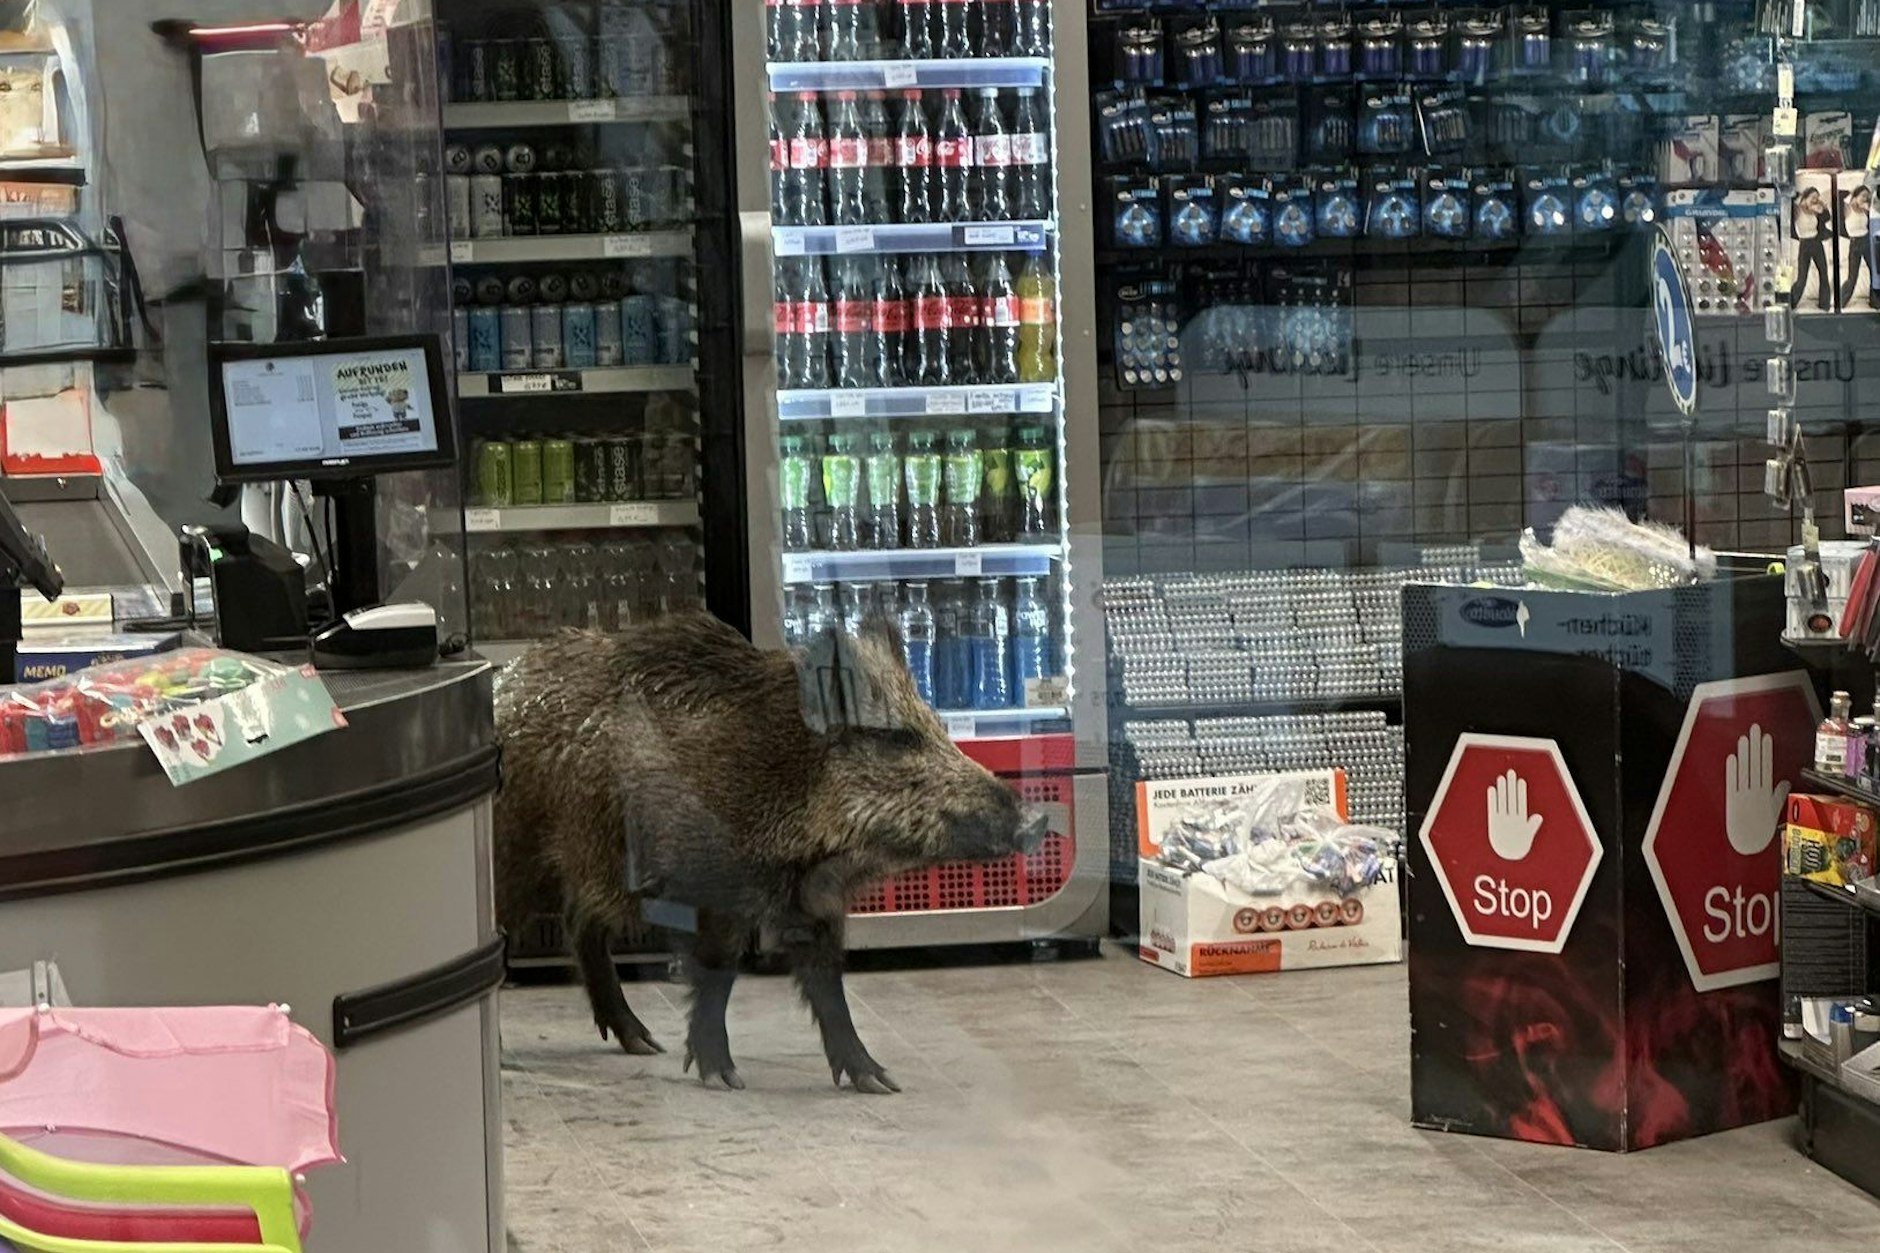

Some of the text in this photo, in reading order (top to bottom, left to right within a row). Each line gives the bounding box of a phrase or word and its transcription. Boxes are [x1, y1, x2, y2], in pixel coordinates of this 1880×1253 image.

[337, 361, 408, 379] AUFRUNDEN
[1153, 787, 1177, 800] JEDE
[1180, 785, 1227, 798] BATTERIE
[1473, 874, 1552, 930] Stop
